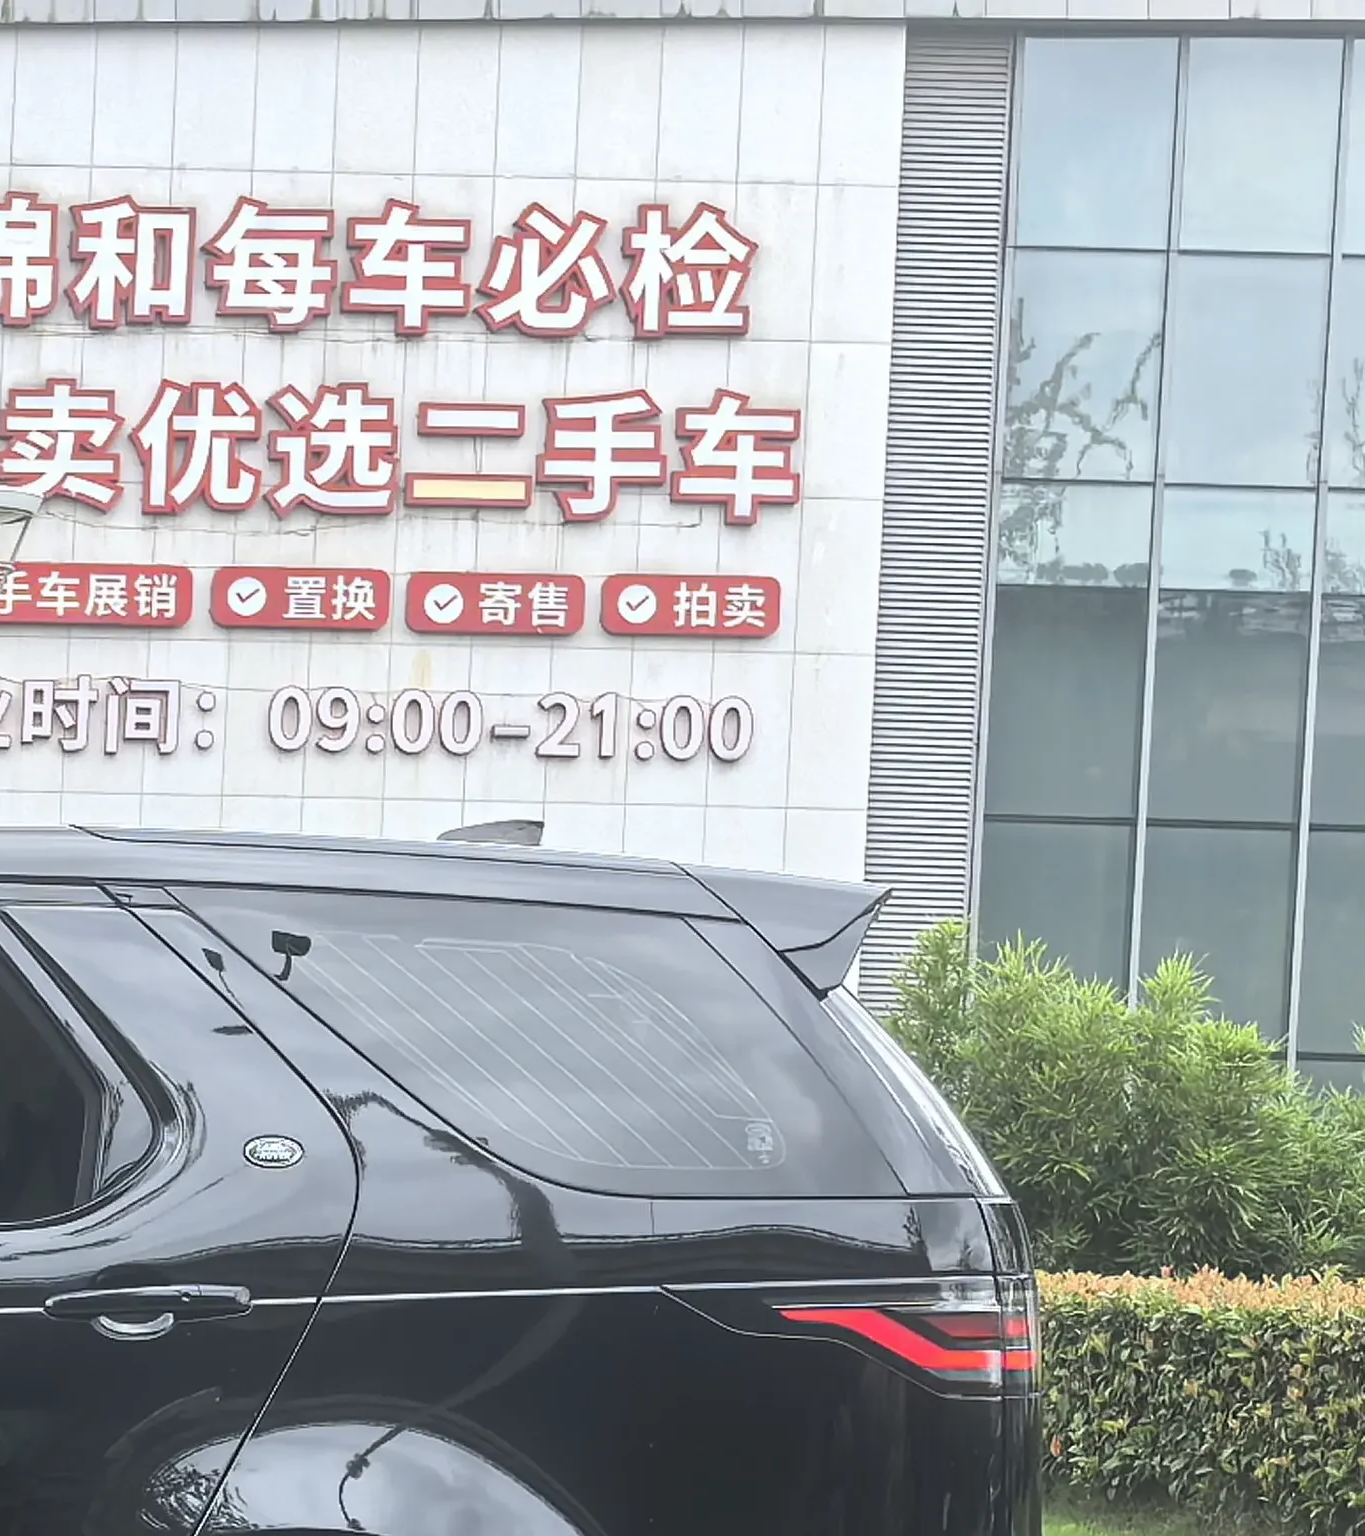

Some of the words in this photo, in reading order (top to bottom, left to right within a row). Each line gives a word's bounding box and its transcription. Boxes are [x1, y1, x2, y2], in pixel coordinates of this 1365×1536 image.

[282, 575, 377, 622] 置换
[478, 581, 569, 628] 寄售
[673, 582, 767, 629] 拍卖
